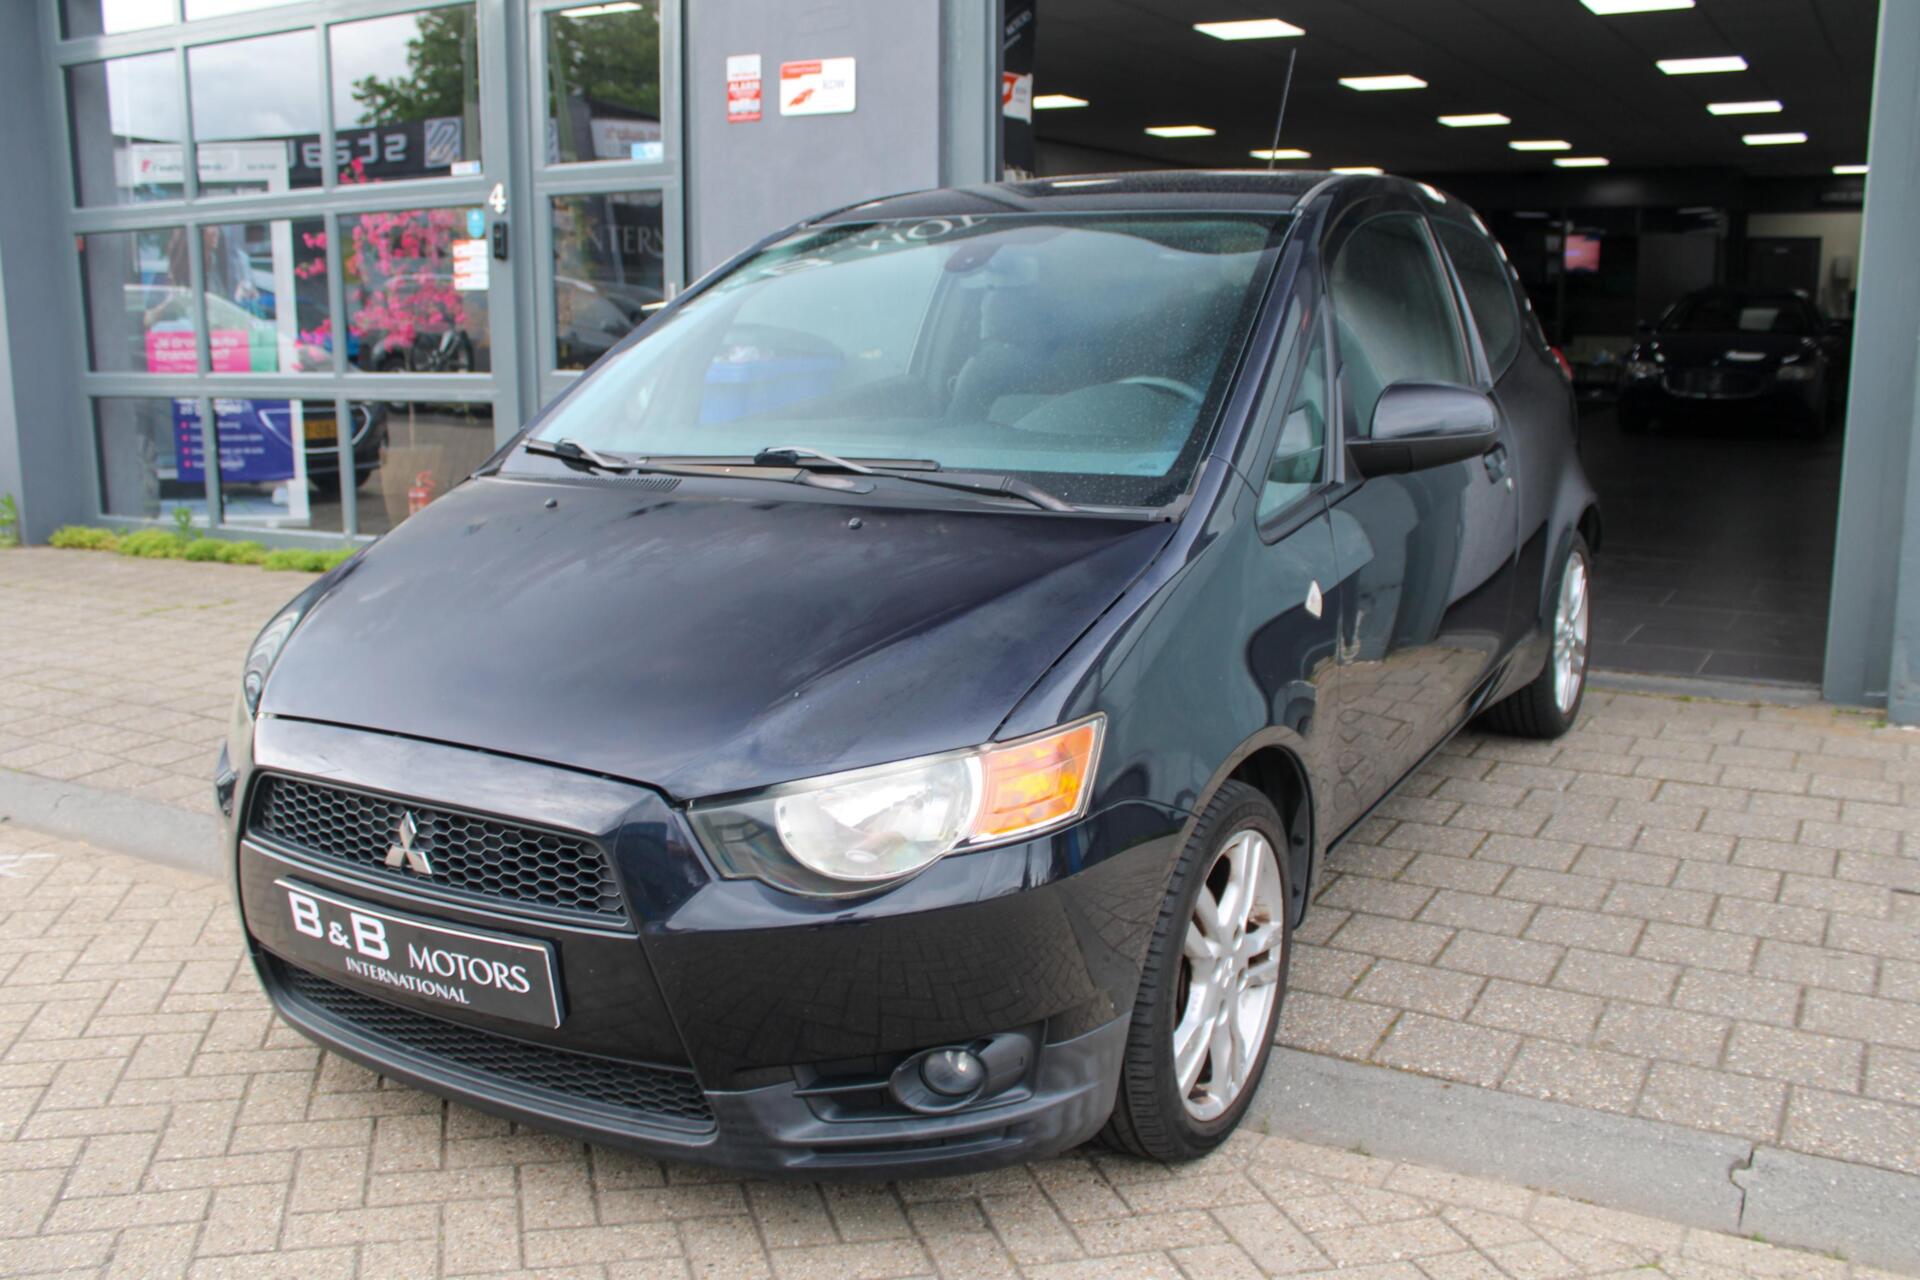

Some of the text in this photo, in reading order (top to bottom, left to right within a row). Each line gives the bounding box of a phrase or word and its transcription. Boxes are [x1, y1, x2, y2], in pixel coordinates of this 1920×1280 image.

[488, 182, 507, 214] 4
[345, 956, 470, 1005] INTERNATIONAL
[408, 942, 531, 993] MOTORS
